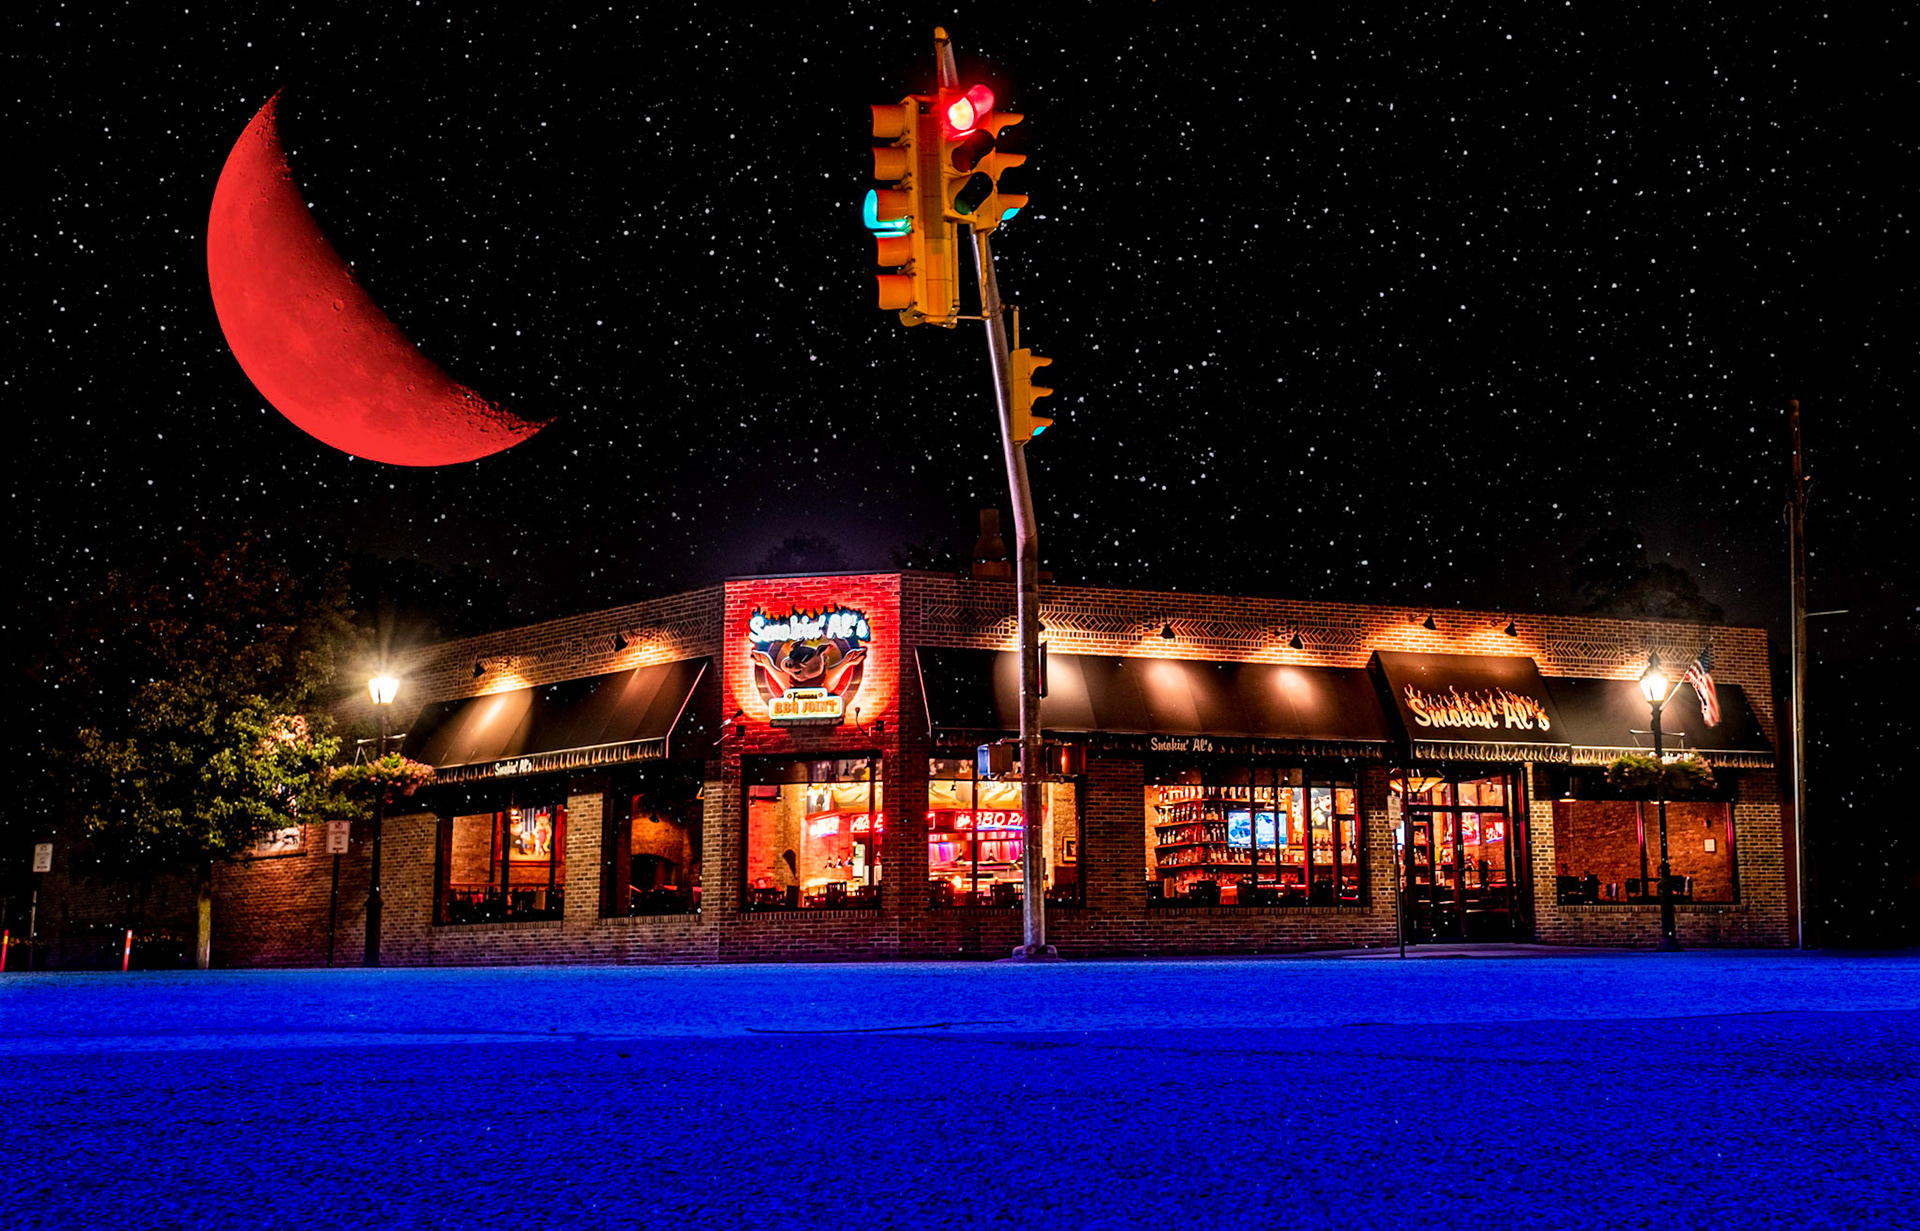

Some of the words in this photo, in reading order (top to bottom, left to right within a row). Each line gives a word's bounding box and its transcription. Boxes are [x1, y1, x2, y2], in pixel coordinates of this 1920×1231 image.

[749, 614, 826, 642] Smokin'
[827, 613, 869, 639] Al's
[774, 701, 799, 714] BBQ
[802, 700, 837, 713] JOINT
[1411, 698, 1499, 729] Smokin'
[1502, 700, 1550, 731] Al's
[1150, 736, 1189, 751] Smokin'
[1192, 738, 1213, 752] Al's
